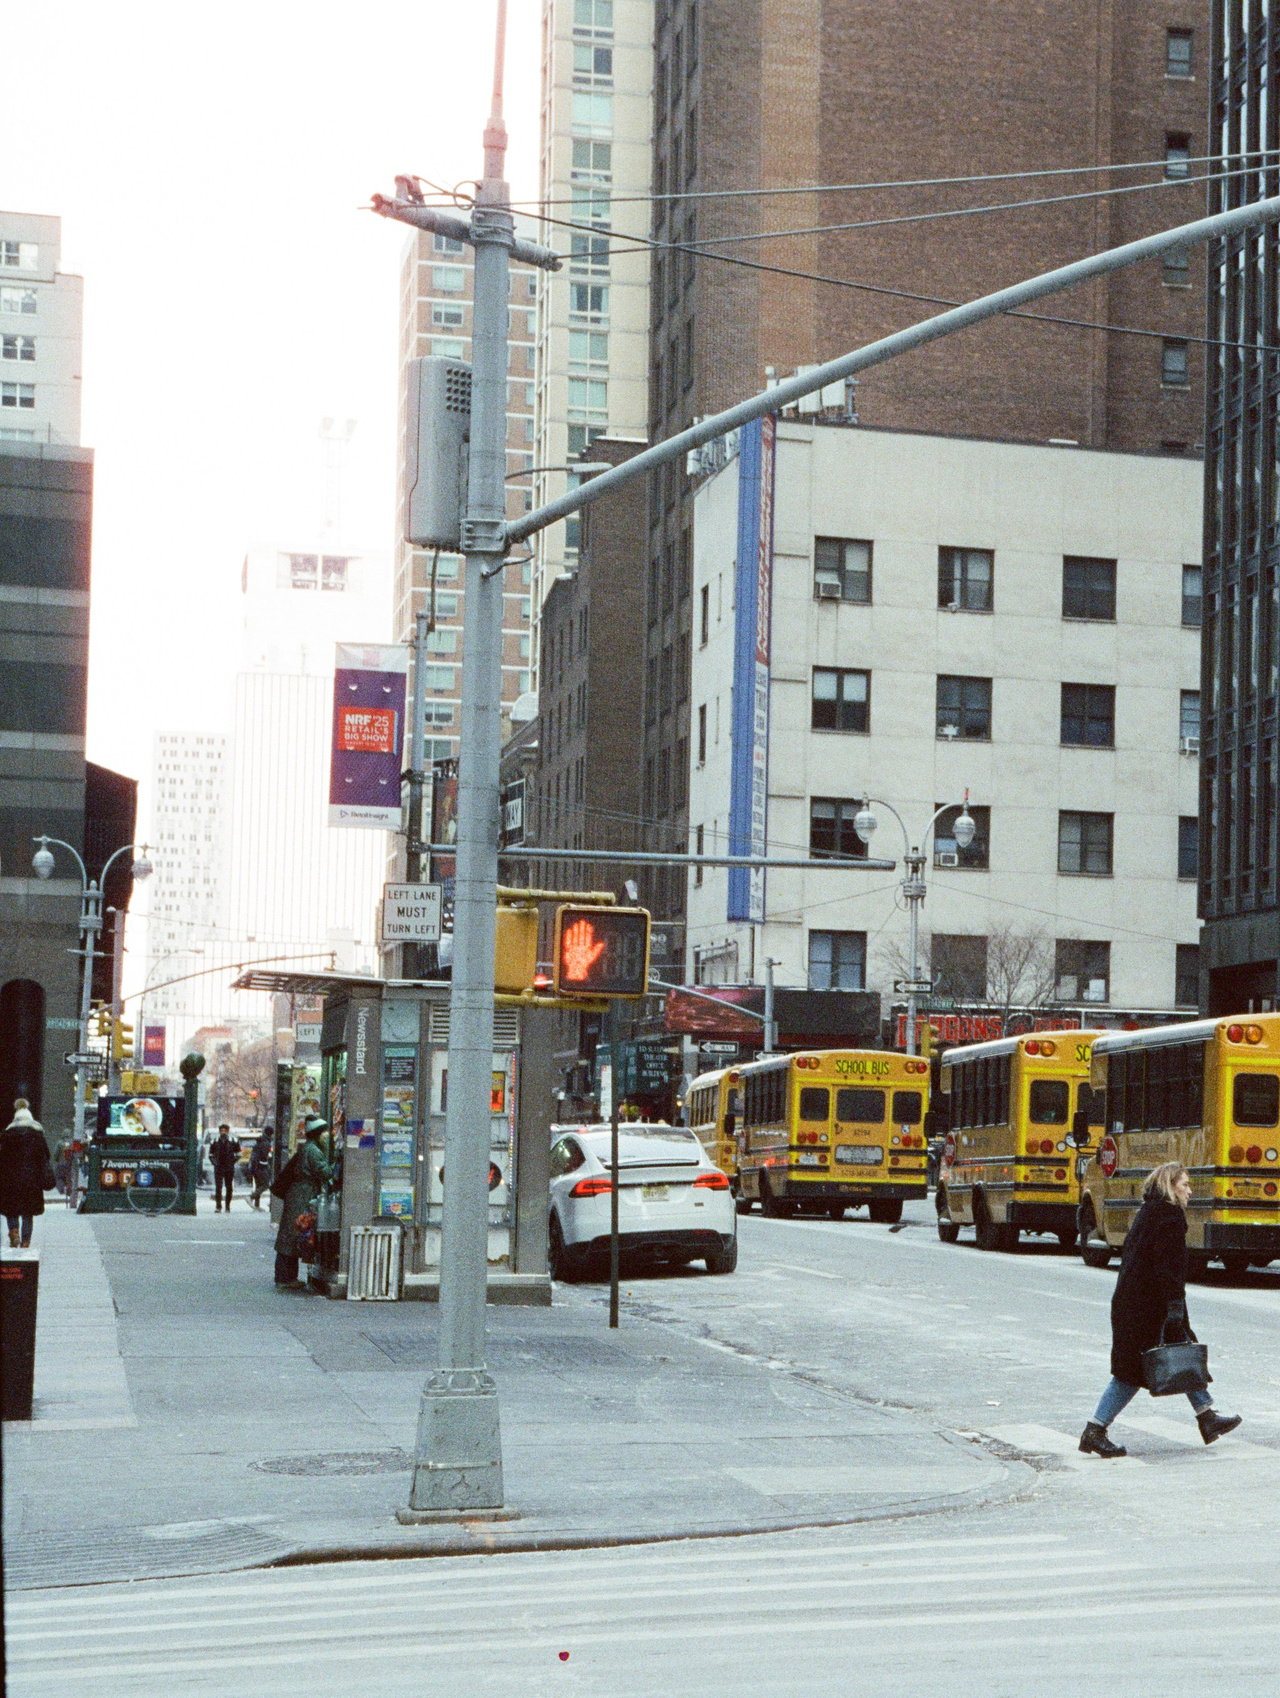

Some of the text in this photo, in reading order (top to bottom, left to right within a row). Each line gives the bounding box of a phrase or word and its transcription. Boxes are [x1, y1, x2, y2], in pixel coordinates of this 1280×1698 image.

[344, 713, 390, 728] NRF '25
[344, 725, 389, 735] RETAIL'S
[344, 733, 389, 742] BIG SHOW
[388, 890, 437, 900] LEFT LANE
[397, 906, 427, 918] MUST
[387, 923, 436, 934] TURN LEFT
[355, 1007, 370, 1075] Newsstand
[835, 1060, 890, 1075] SCHOOL BUS
[1102, 1150, 1116, 1165] STOP
[101, 1160, 170, 1169] 7 Avenue Station
